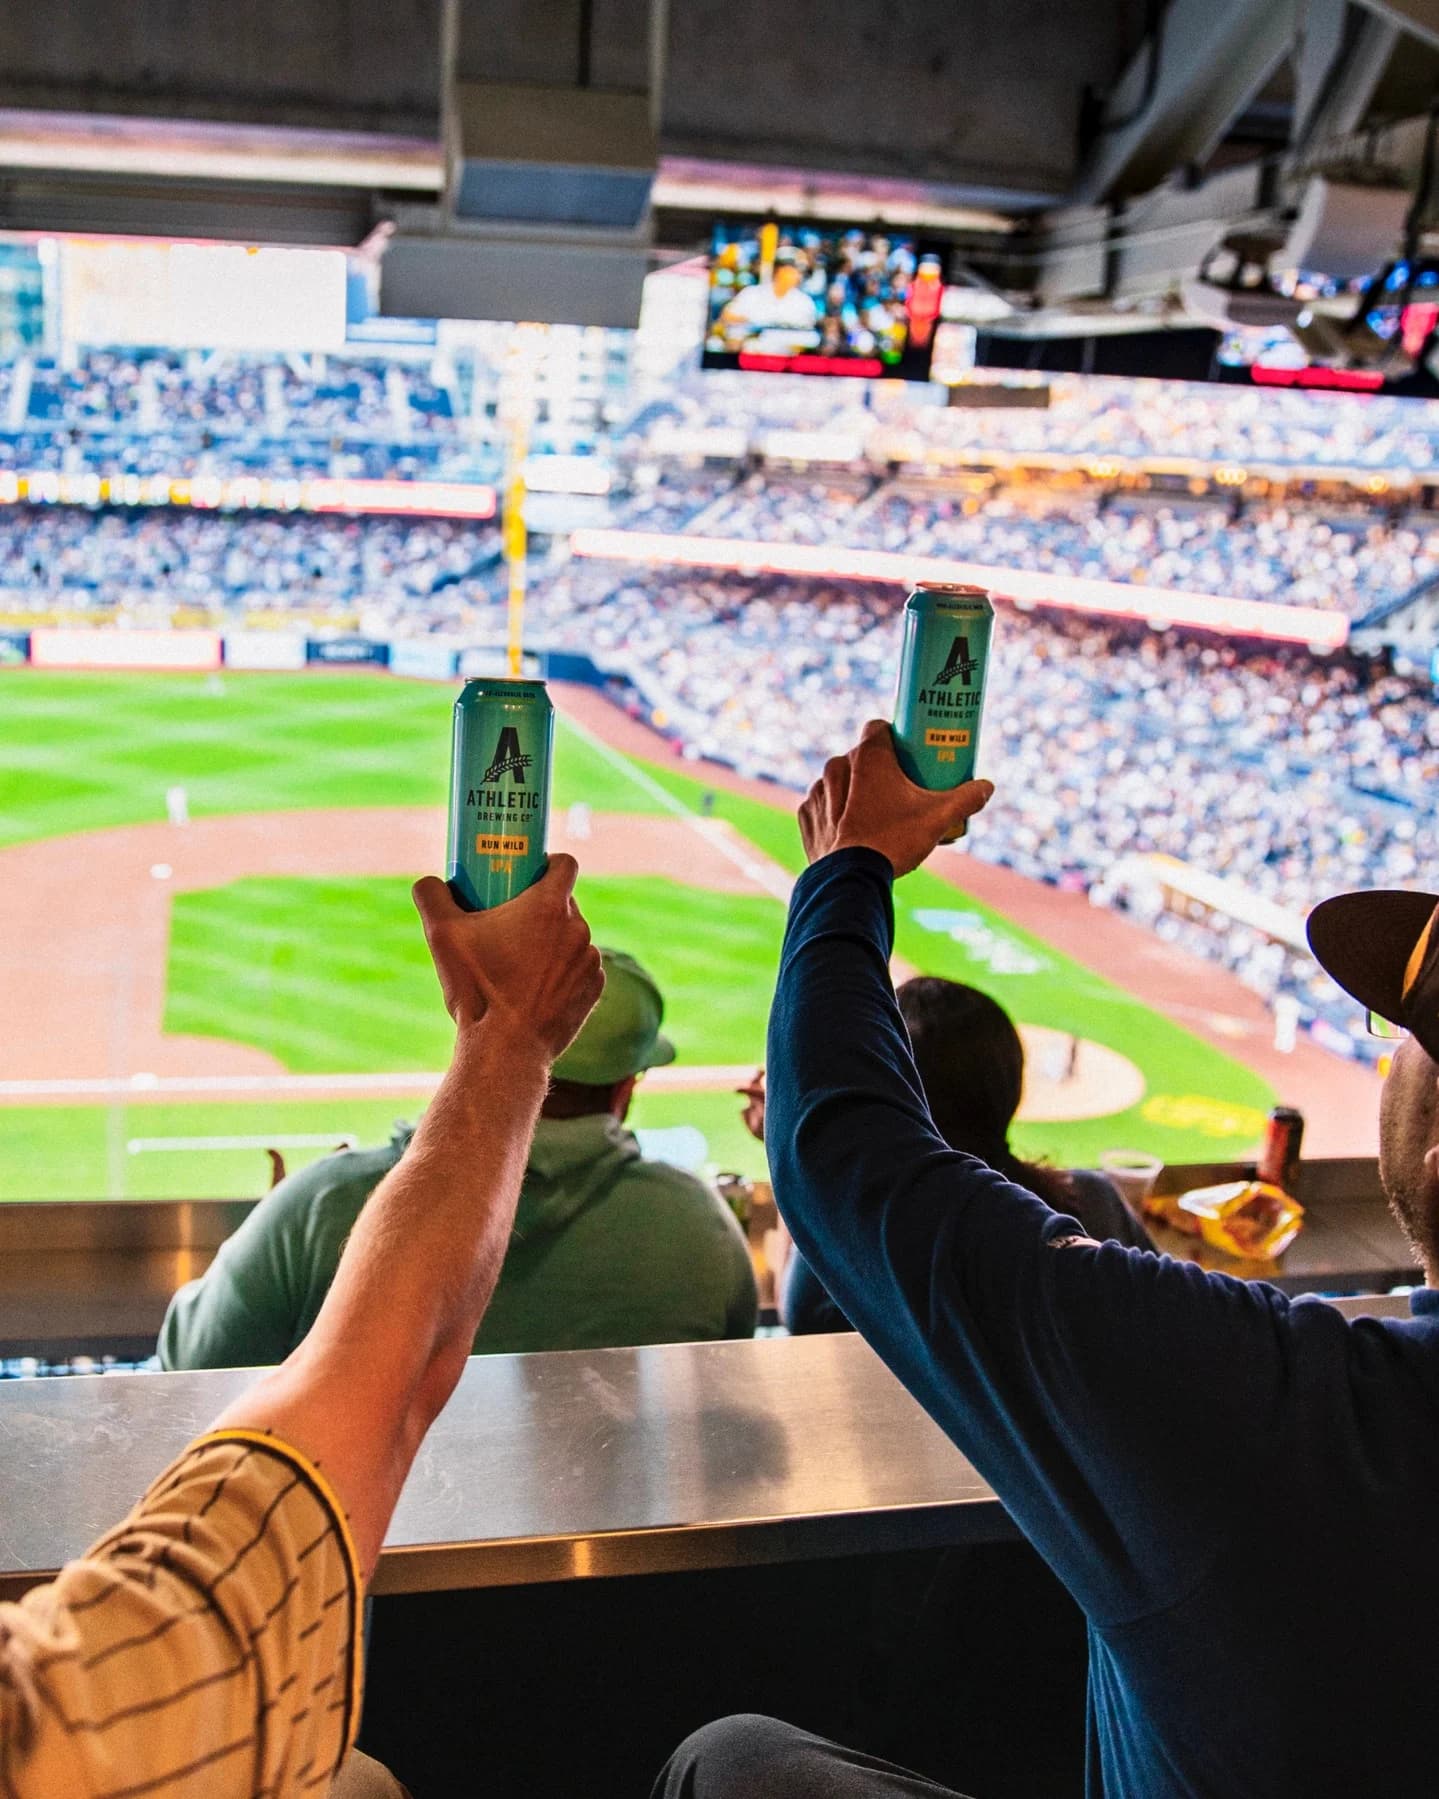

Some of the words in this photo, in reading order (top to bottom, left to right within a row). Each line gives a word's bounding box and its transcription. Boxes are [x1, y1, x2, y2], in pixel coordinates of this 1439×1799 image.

[932, 636, 978, 686] A
[919, 689, 981, 707] ATHLETIC
[928, 709, 963, 719] BREWING
[930, 733, 946, 742] RUN
[949, 734, 967, 742] WILD
[480, 727, 532, 785] A
[466, 790, 540, 809] ATHLETIC
[477, 812, 518, 822] BREWING
[481, 840, 499, 849] RUN
[503, 841, 524, 850] WILD
